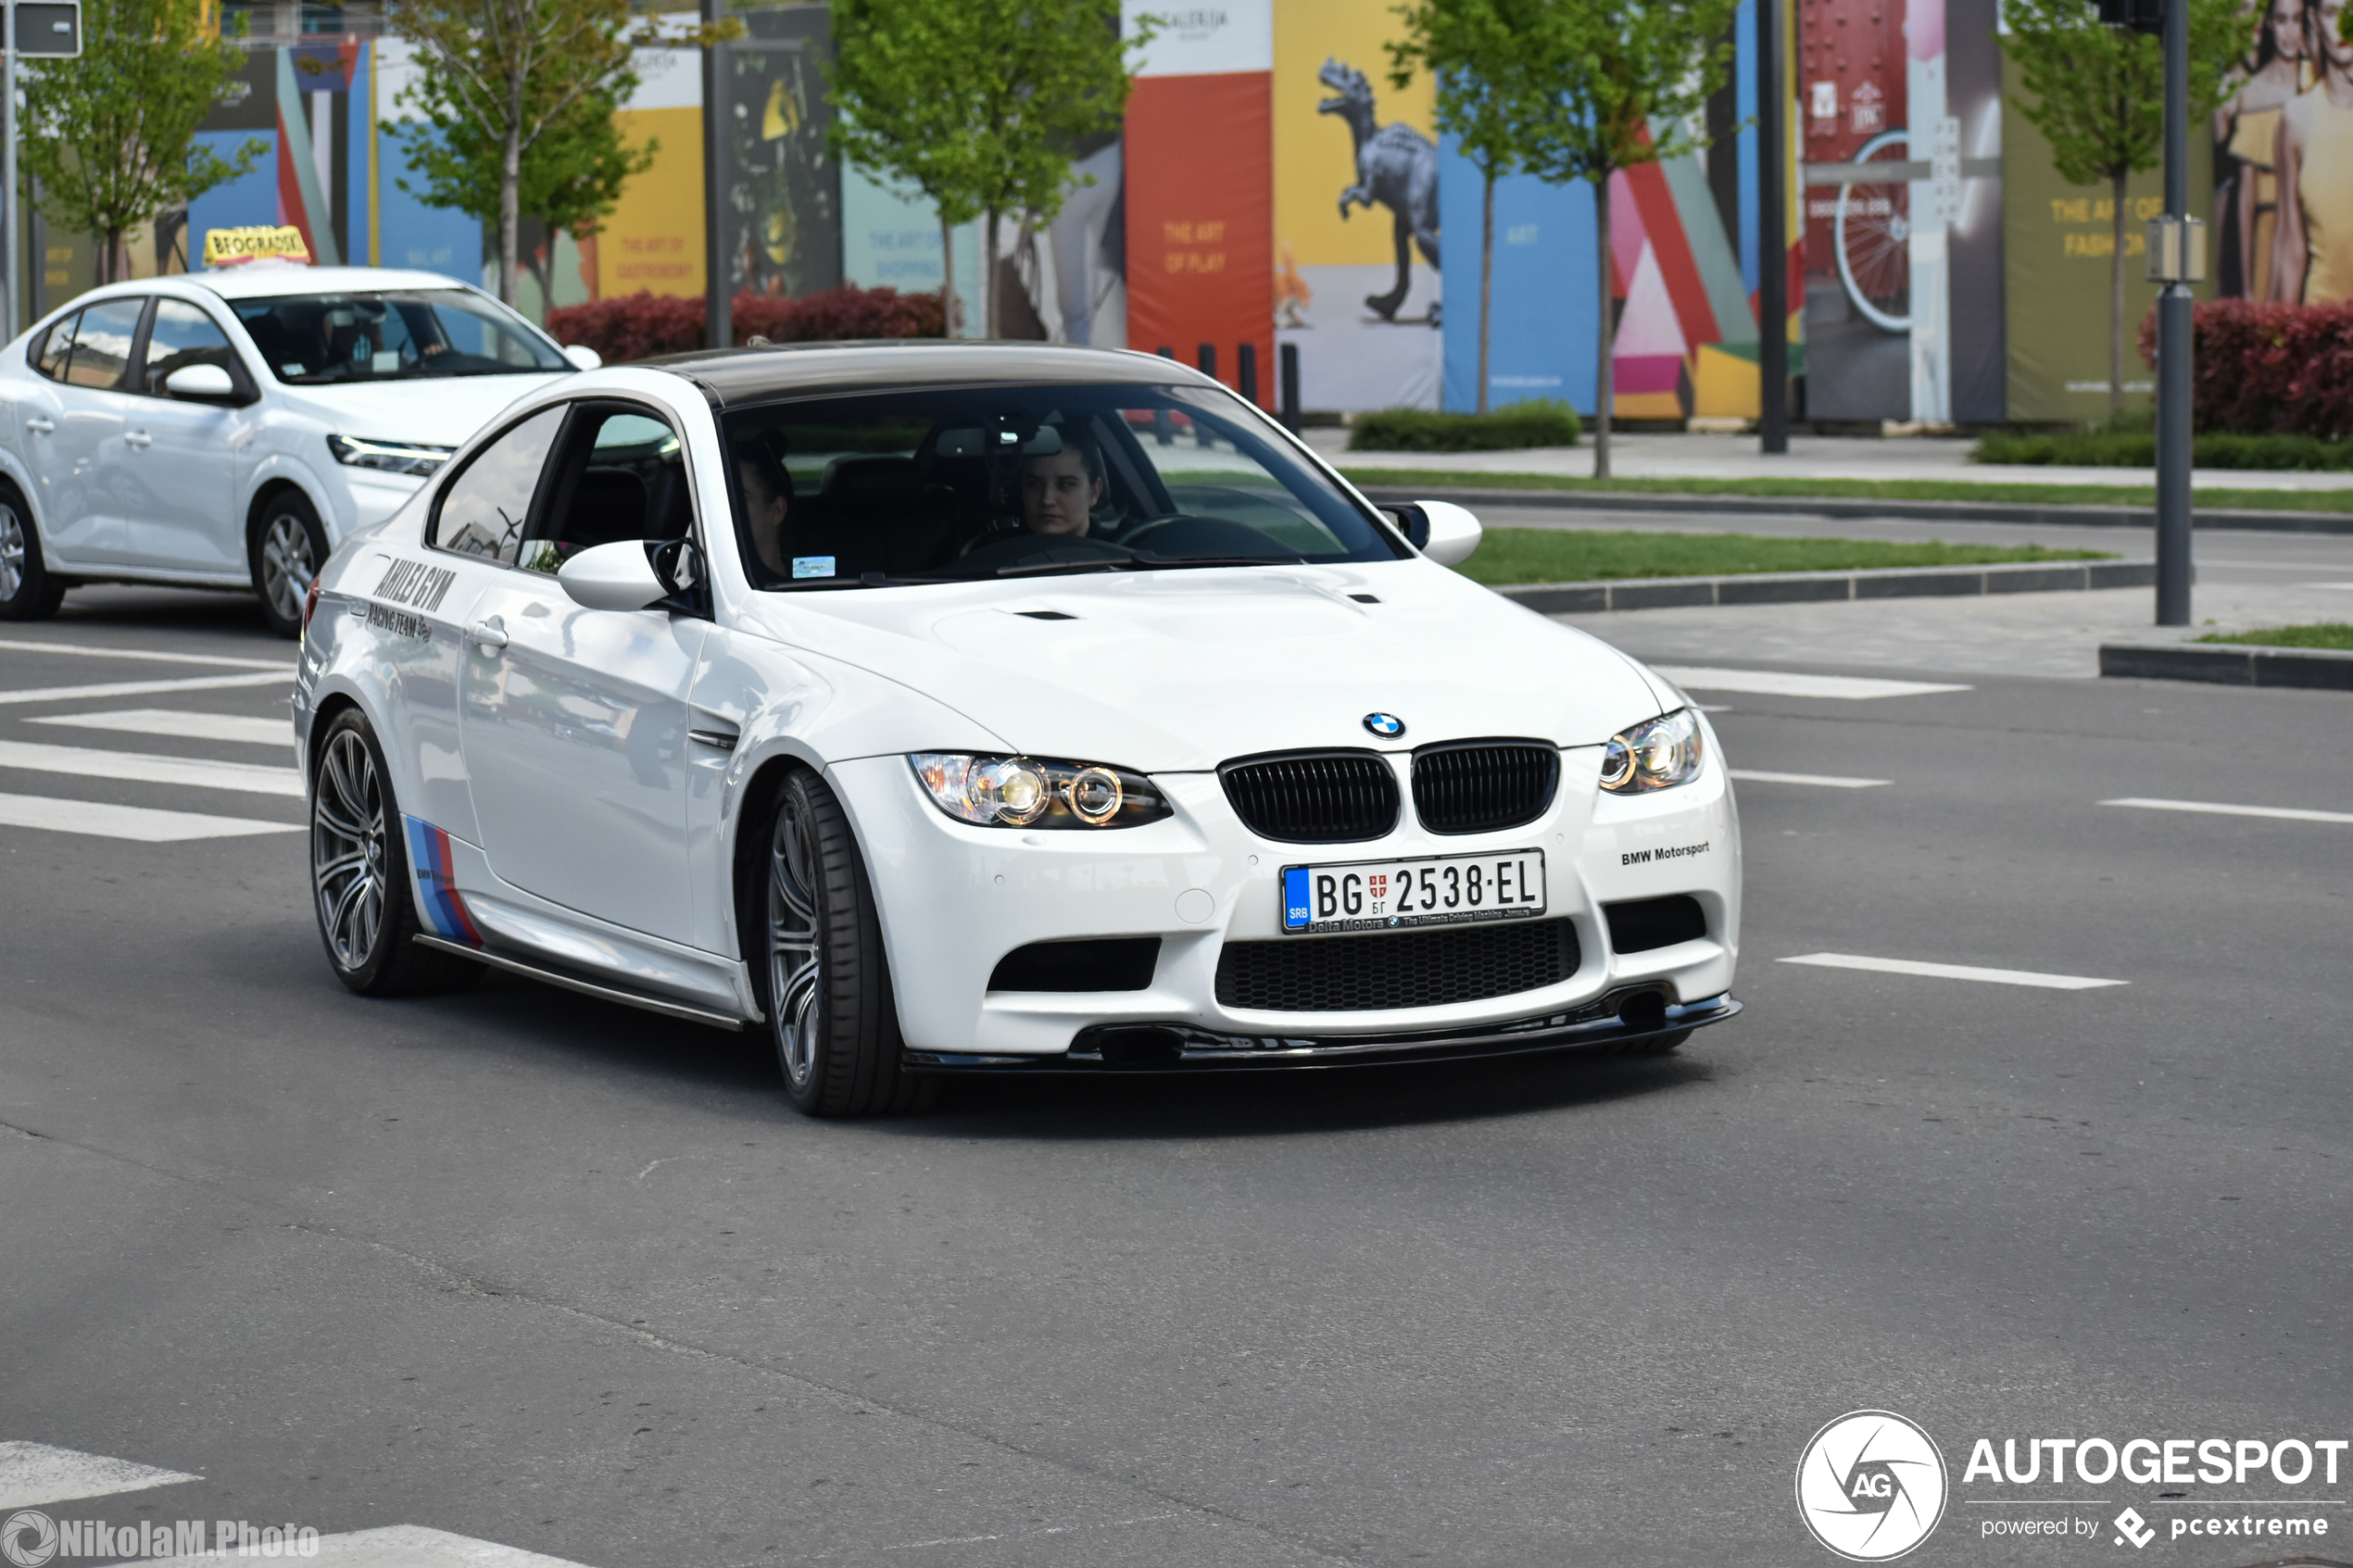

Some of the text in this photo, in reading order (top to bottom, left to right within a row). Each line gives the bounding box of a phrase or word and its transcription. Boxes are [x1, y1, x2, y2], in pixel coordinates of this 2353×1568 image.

[2051, 198, 2088, 221] THE
[411, 567, 457, 612] GYM
[367, 604, 417, 638] RACING TEAM
[1621, 840, 1710, 866] BMW Motorsport
[1316, 873, 1363, 918] BG
[1290, 908, 1308, 919] SRB
[1308, 920, 1340, 933] Delta
[1341, 918, 1385, 931] Motors
